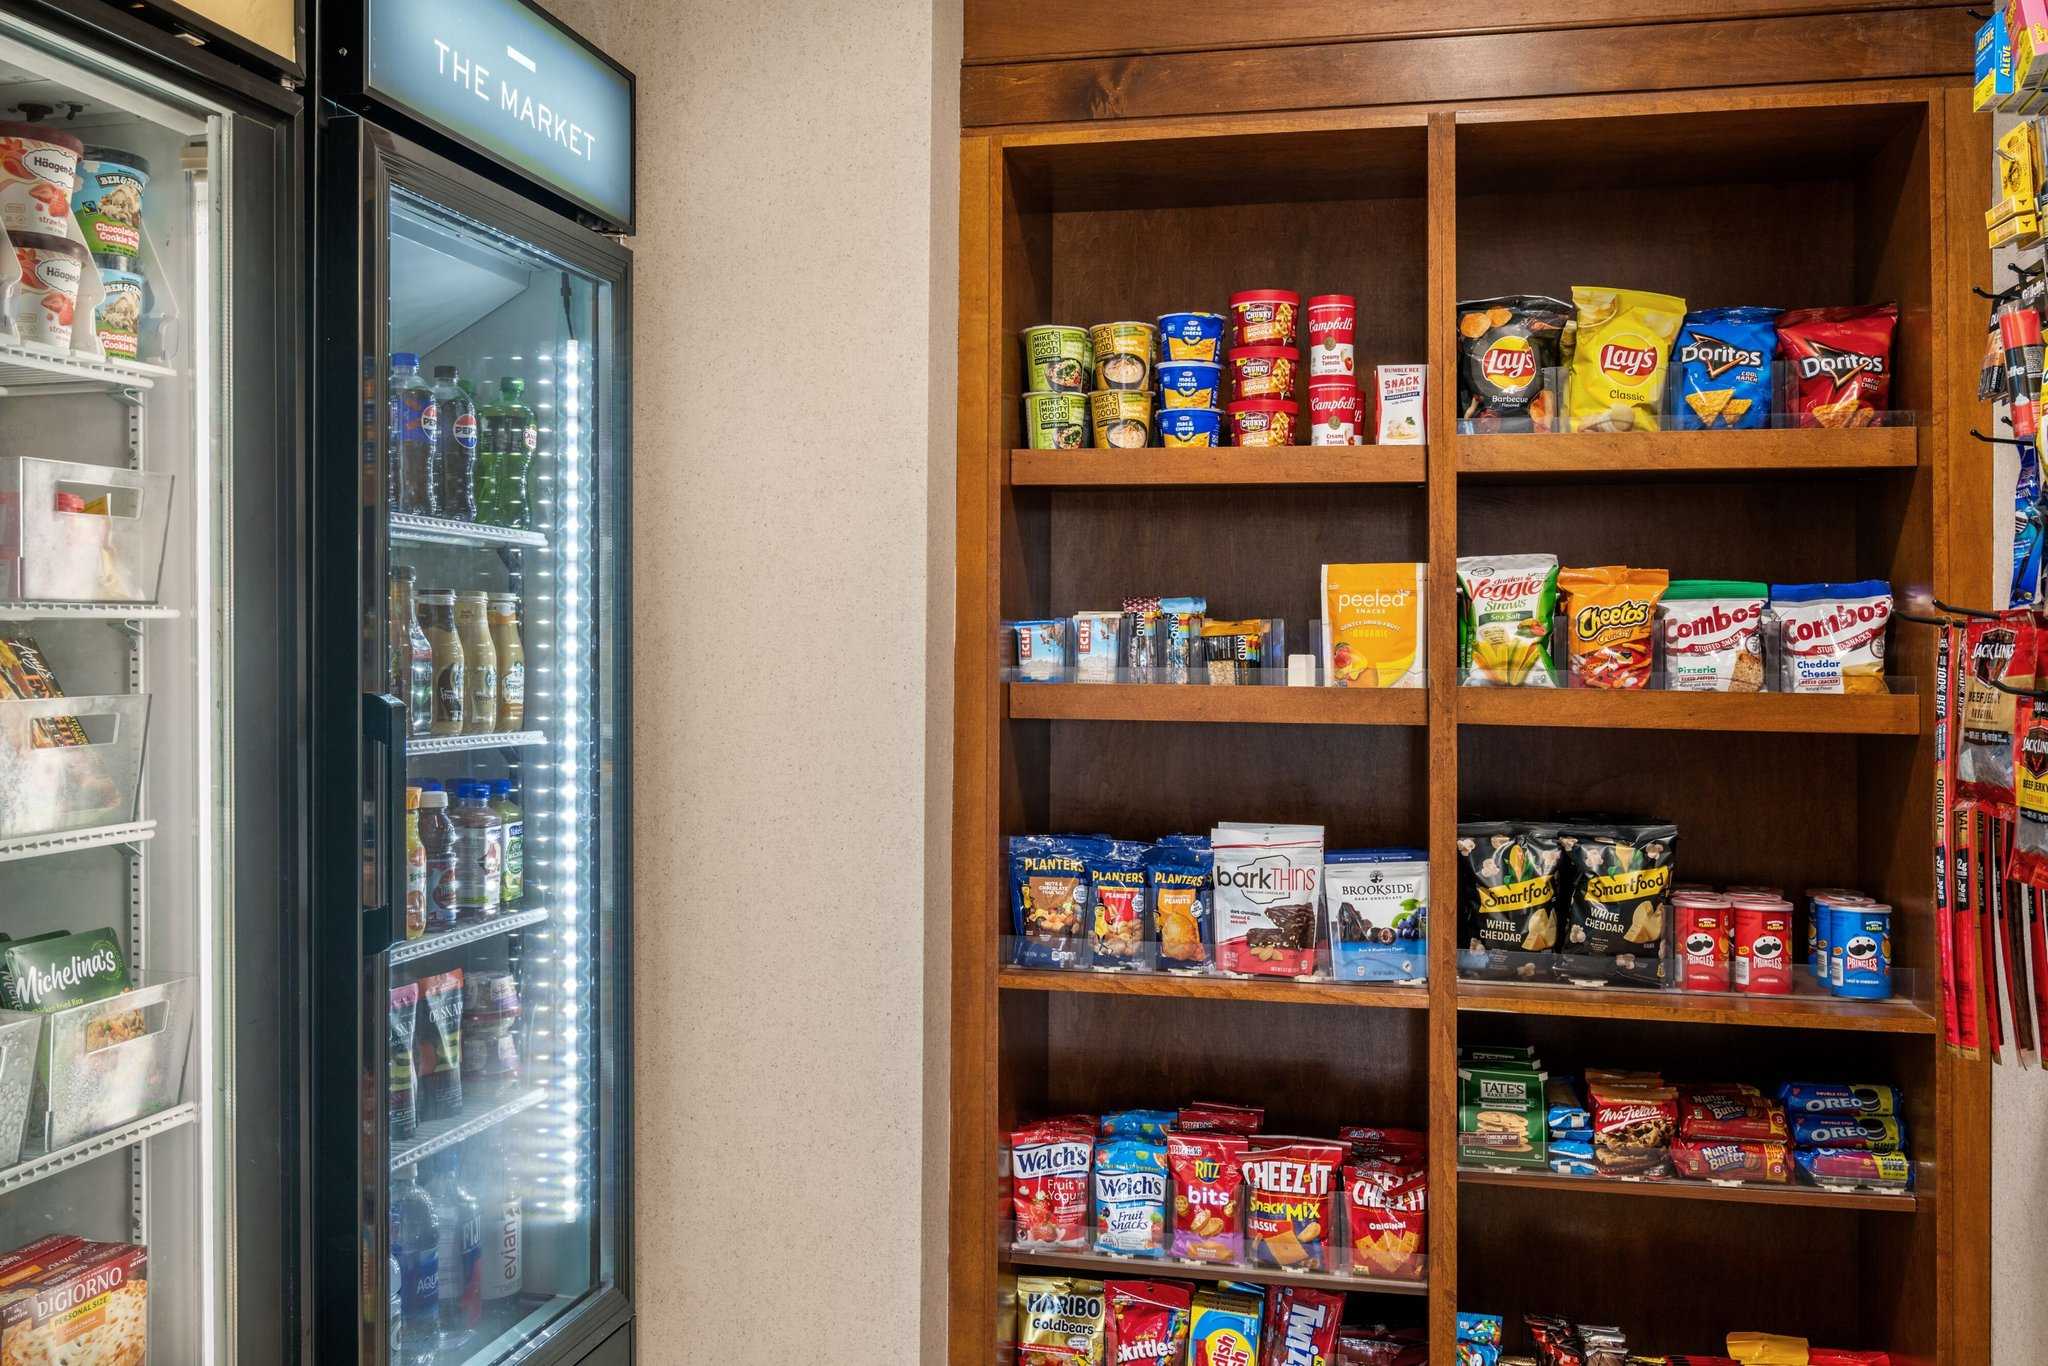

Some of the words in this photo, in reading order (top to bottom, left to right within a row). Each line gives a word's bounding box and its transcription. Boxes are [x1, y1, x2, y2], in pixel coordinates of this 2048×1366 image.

[2000, 45, 2012, 77] ALEVE
[433, 39, 490, 101] THE
[500, 80, 596, 161] MARKET
[1246, 311, 1272, 320] CHUNKY
[1309, 316, 1353, 334] Campbell's
[1033, 331, 1059, 342] MIKE'S
[1034, 340, 1059, 349] MIGHTY
[1035, 347, 1060, 355] GOOD
[1604, 345, 1656, 376] Lay's
[1680, 346, 1762, 366] Doritos
[1243, 365, 1269, 374] CHUNKY
[1486, 349, 1534, 378] Lay's
[1802, 355, 1884, 378] Doritos
[1735, 375, 1759, 383] RANCH
[1741, 370, 1758, 378] COOL
[1384, 376, 1420, 389] SNACK
[1095, 393, 1117, 404] MIKE'S
[1492, 395, 1528, 404] Barbecue
[1609, 389, 1645, 402] Classic
[1041, 398, 1068, 408] MIKE'S
[1041, 406, 1068, 414] MIGHTY
[1311, 396, 1356, 412] Campbell's
[1042, 412, 1068, 421] GOOD
[1097, 408, 1118, 418] GOOD
[1241, 419, 1267, 428] CHUNKY
[1467, 578, 1543, 601] Veggie
[1338, 589, 1406, 612] peeled
[1484, 600, 1527, 612] Straws
[1506, 612, 1520, 620] Salt
[1577, 602, 1648, 640] Cheetos
[1665, 601, 1762, 643] Combos
[1783, 600, 1889, 644] Combos
[1136, 611, 1145, 637] KIND
[1237, 635, 1247, 661] KIND
[1694, 641, 1720, 652] STUFFED
[1971, 643, 1994, 659] JACK
[1678, 665, 1716, 674] Pizzeria
[1797, 659, 1841, 668] Cheddar
[1801, 669, 1838, 678] Cheese
[1968, 691, 1985, 702] BEEF
[2023, 779, 2033, 789] BEEF
[1936, 778, 1945, 829] ORIGINAL
[1024, 858, 1085, 872] PLANTERS
[1092, 871, 1144, 882] PLANTERS
[1154, 872, 1203, 887] PLANTERS
[1342, 883, 1414, 895] BROOKSIDE
[1591, 873, 1665, 898] Smartfood
[1590, 907, 1620, 923] WHITE
[1486, 919, 1516, 931] WHITE
[1585, 918, 1625, 934] CHEDDAR
[1480, 929, 1521, 942] CHEDDAR
[1687, 954, 1715, 968] PRINGLES
[1753, 956, 1783, 970] PRINGLES
[1847, 955, 1878, 971] PRINGLES
[16, 949, 117, 1004] Michelina's
[1482, 1081, 1525, 1095] TATE'S
[1692, 1095, 1727, 1104] Nutter
[1806, 1098, 1863, 1111] OREO
[1600, 1107, 1624, 1123] Mrs.
[1624, 1104, 1662, 1119] Fields
[1714, 1105, 1745, 1119] Butter
[1776, 1115, 1784, 1124] 8
[1811, 1126, 1868, 1141] OREO
[1702, 1144, 1738, 1160] Nutter
[1016, 1146, 1088, 1174] Welch's
[1709, 1153, 1745, 1169] Butter
[1194, 1160, 1221, 1179] RITZ
[1774, 1165, 1782, 1174] 8
[1047, 1179, 1074, 1190] Fruit
[1075, 1180, 1086, 1189] 'n
[1100, 1177, 1162, 1198] Welch's
[1048, 1190, 1086, 1203] Yogurt
[1188, 1185, 1230, 1206] bits
[1250, 1196, 1285, 1214] Snack
[1118, 1210, 1144, 1220] Fruit
[1110, 1219, 1149, 1231] Snacks
[498, 1222, 516, 1280] evian
[54, 1306, 92, 1326] PERSONAL
[92, 1297, 108, 1309] SIZE
[1027, 1293, 1101, 1319] HARIBO
[1032, 1318, 1095, 1335] Goldbears
[1117, 1340, 1177, 1362] Skittles
